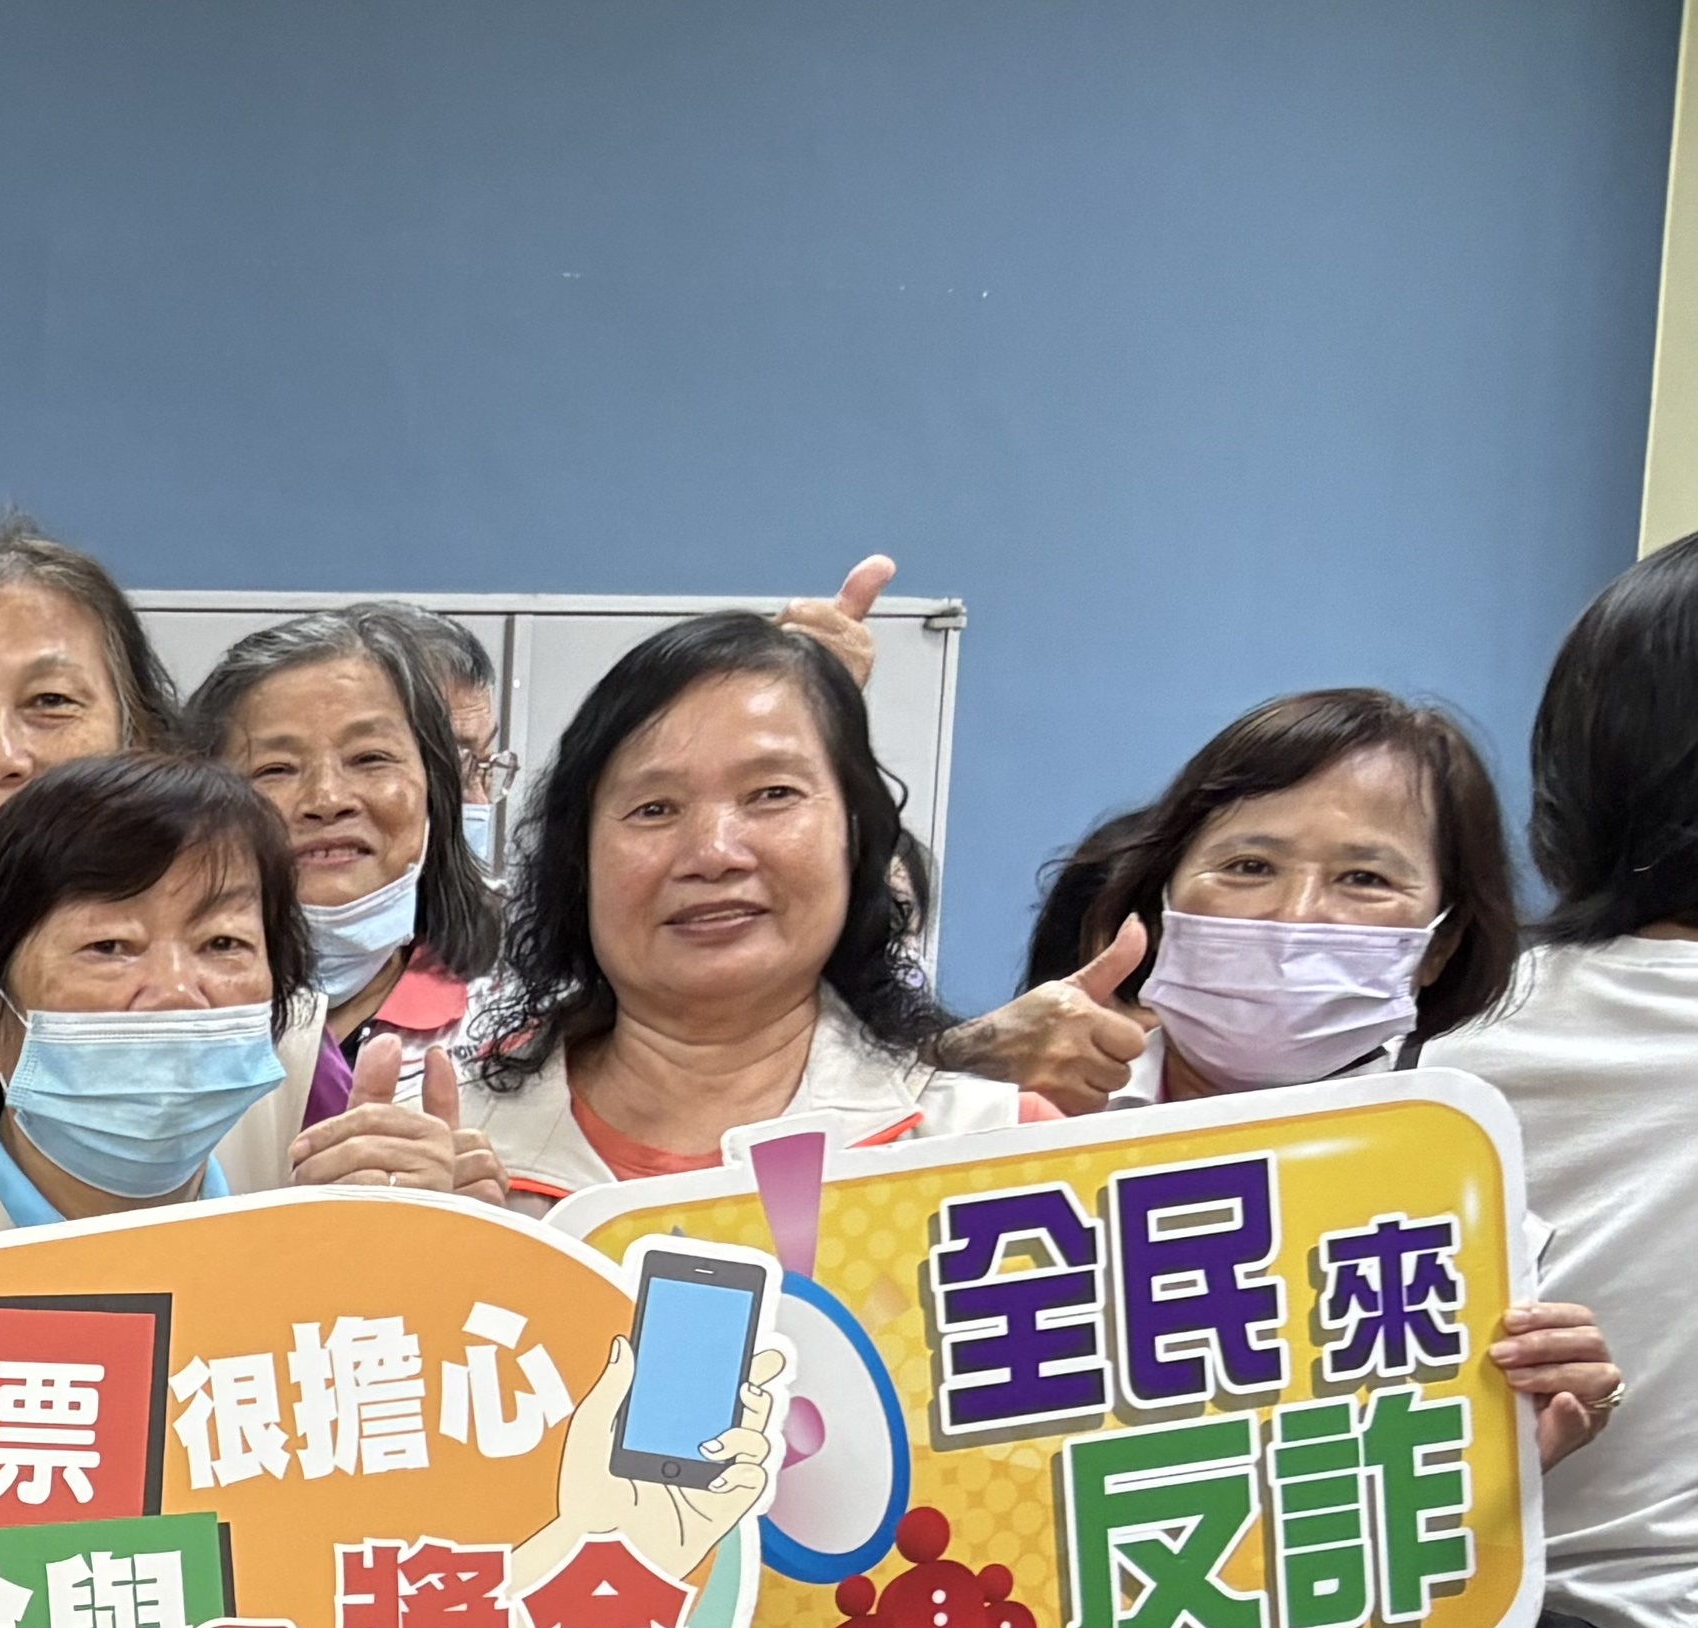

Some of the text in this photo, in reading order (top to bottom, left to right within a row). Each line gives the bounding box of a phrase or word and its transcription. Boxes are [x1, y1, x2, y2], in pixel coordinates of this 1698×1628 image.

[169, 1301, 575, 1490] 很擔心
[935, 1154, 1464, 1430] 全民來
